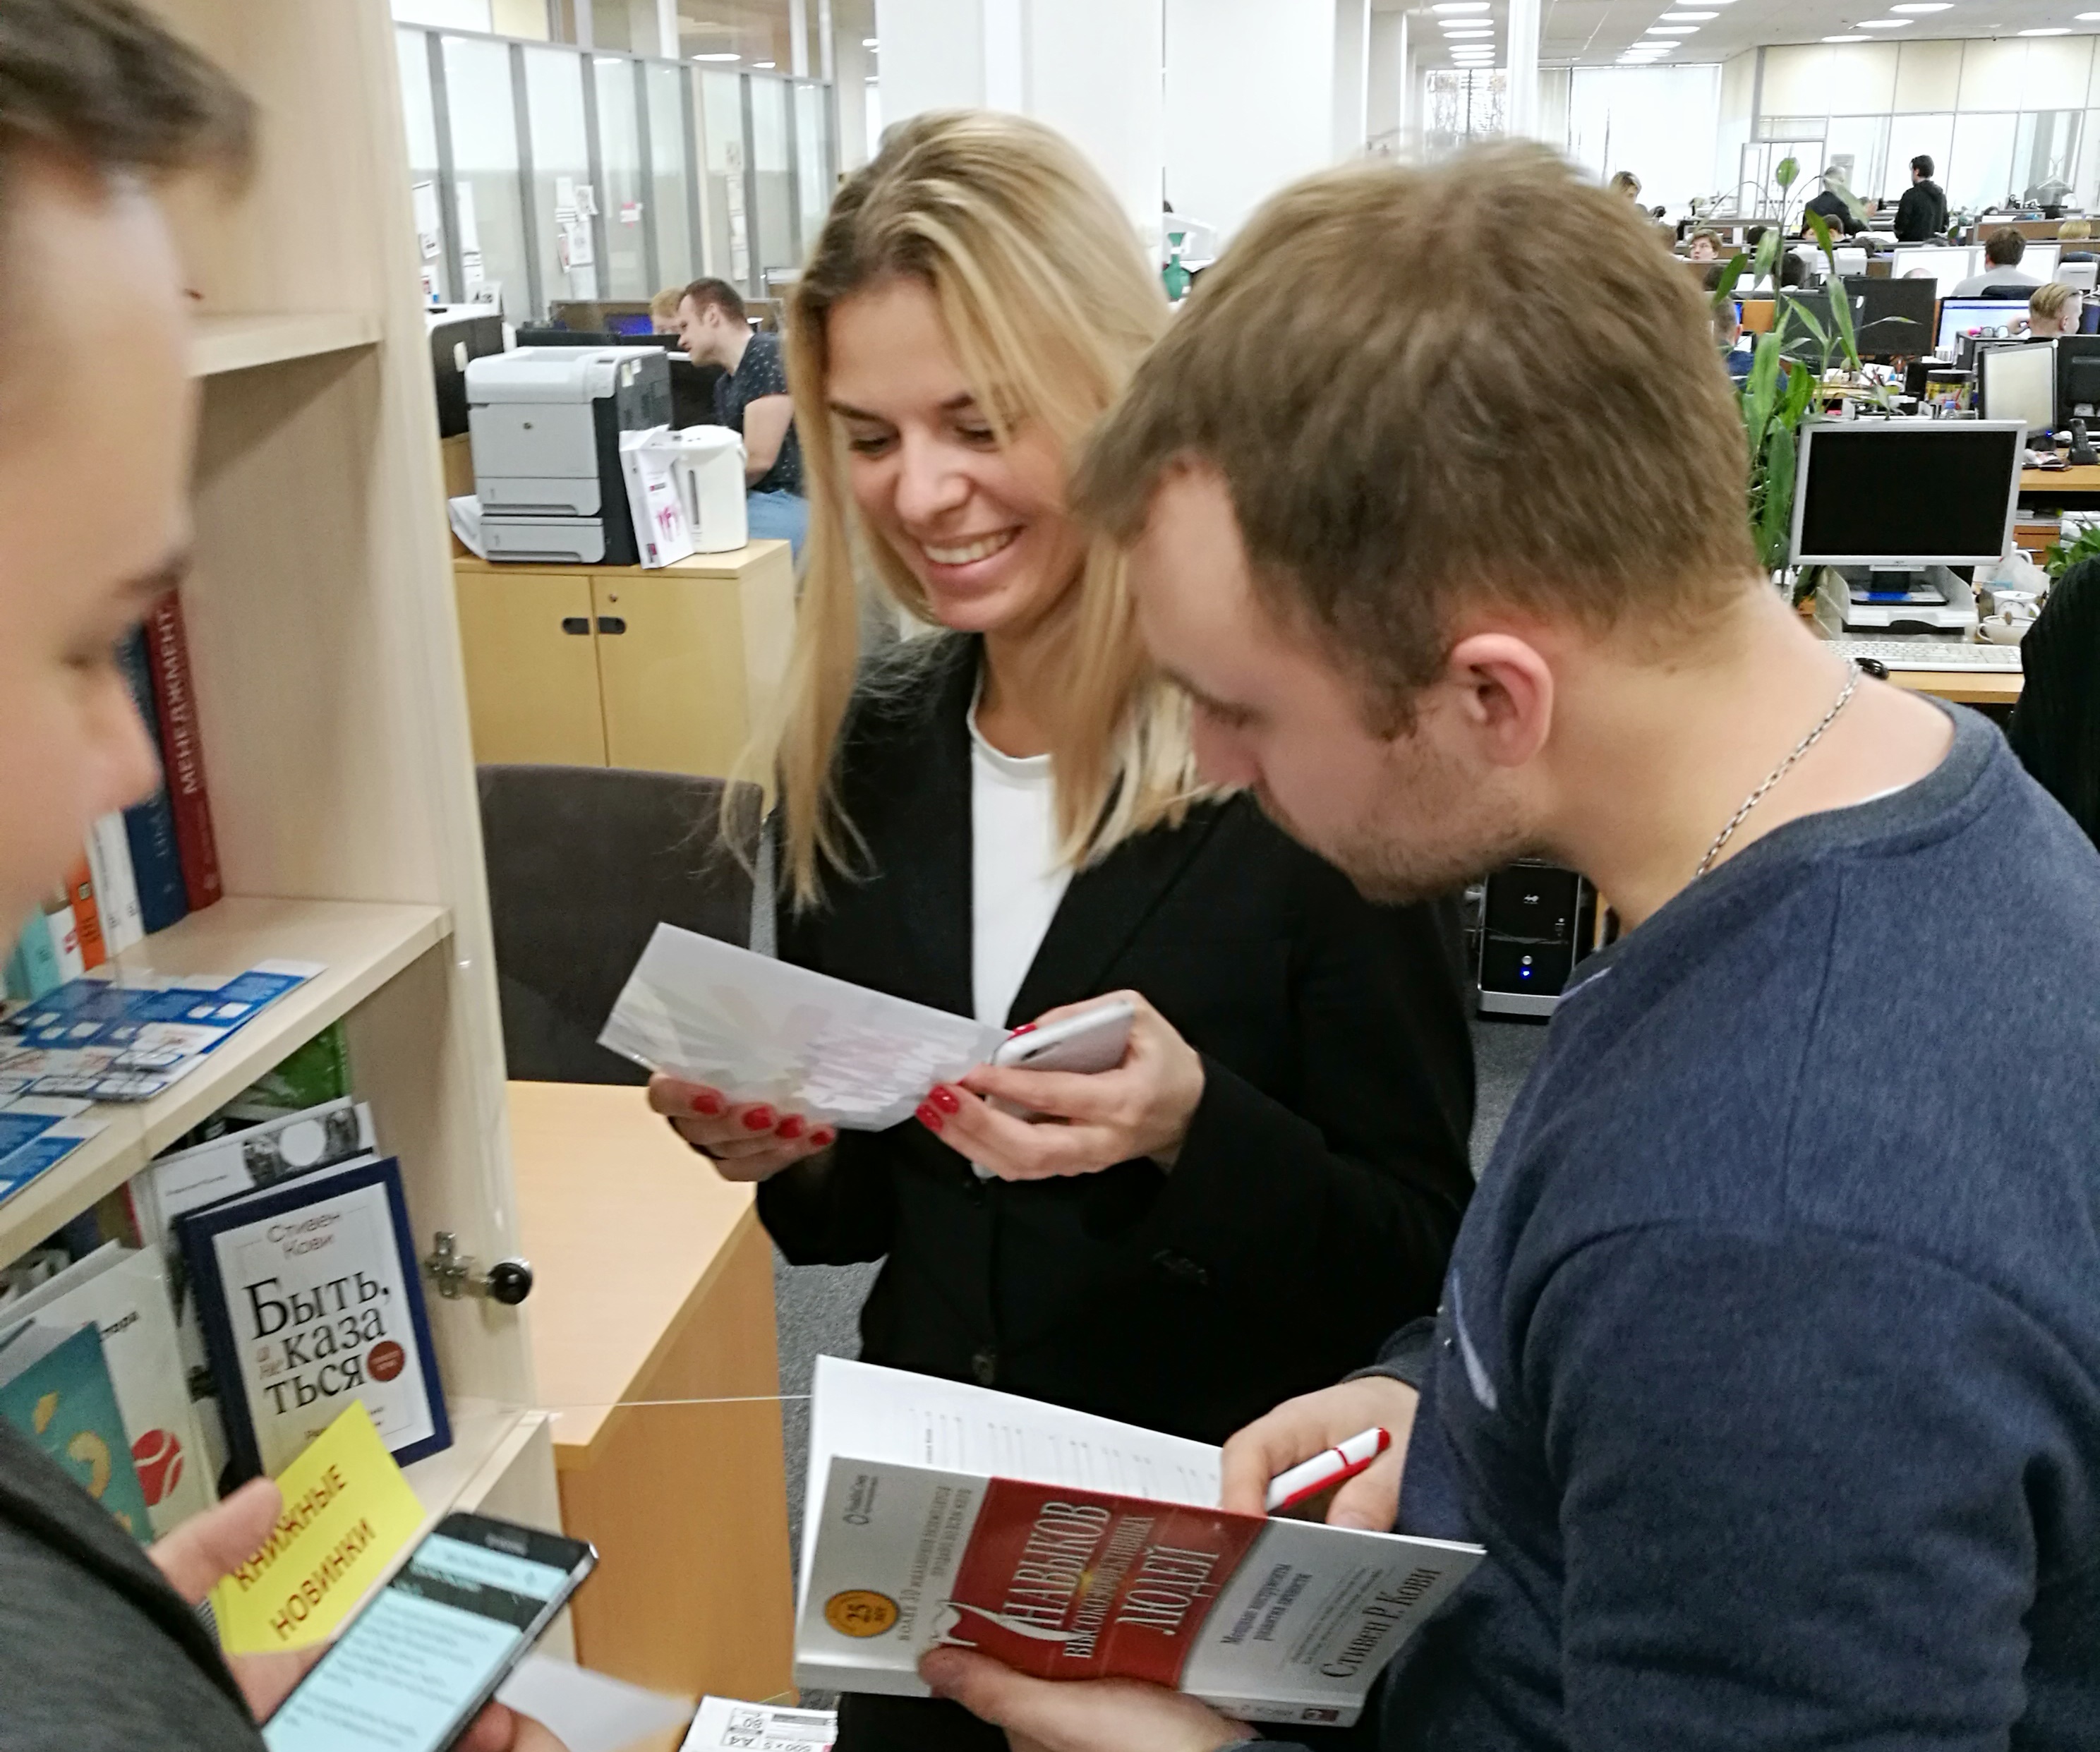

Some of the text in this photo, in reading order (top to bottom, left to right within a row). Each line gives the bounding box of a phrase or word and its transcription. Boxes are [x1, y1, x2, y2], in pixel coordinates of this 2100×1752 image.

[155, 605, 198, 796] МЕНЕДЖМЕНТ
[266, 1212, 342, 1243] Стивен
[284, 1234, 335, 1260] Кови
[233, 1463, 349, 1593] КНИЖНЫЕ
[268, 1517, 377, 1642] НОВИНКИ
[1001, 1501, 1112, 1626] НАВЫКОВ
[1114, 1544, 1223, 1636] ЛЮДЕЙ
[1319, 1621, 1393, 1678] Стивен
[1375, 1566, 1442, 1607] Кови
